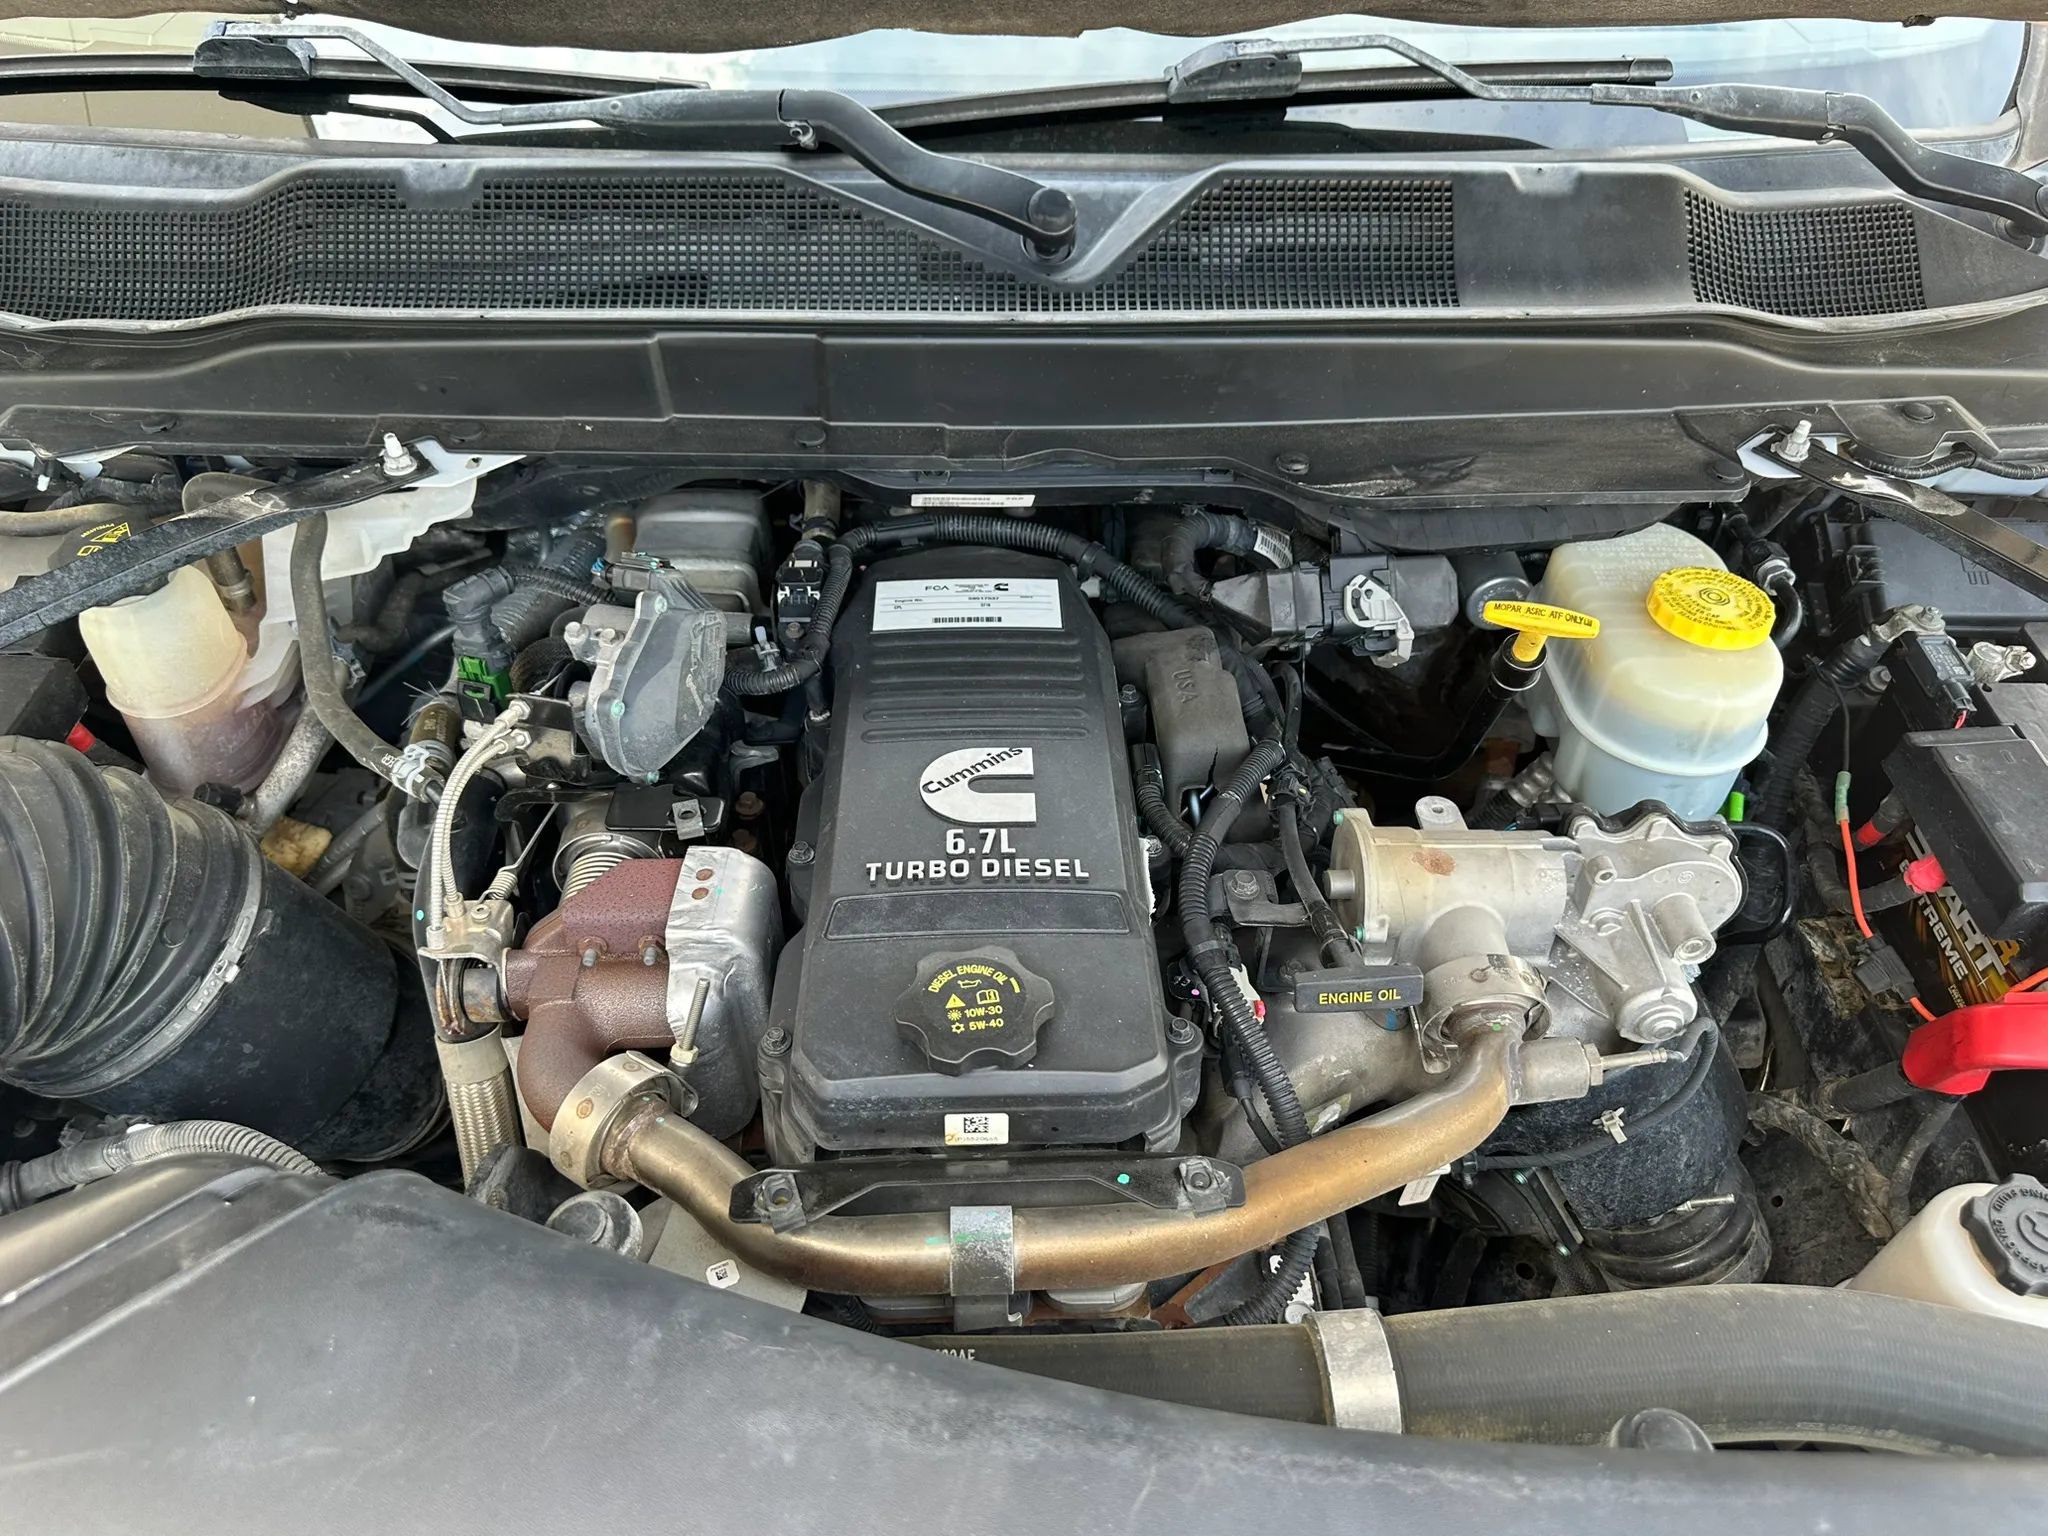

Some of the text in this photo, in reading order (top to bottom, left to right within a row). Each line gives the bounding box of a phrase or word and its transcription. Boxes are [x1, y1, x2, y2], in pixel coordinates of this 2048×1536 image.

[1493, 603, 1522, 614] MOPAR
[1548, 611, 1564, 620] ATF
[1564, 613, 1585, 625] ONLY
[1171, 669, 1199, 704] USA
[922, 747, 1023, 794] Cummins
[946, 828, 1017, 856] 6.7L
[865, 858, 1090, 884] TURBO DIESEL
[1898, 857, 1968, 980] ETREME
[928, 964, 1009, 993] DIESEL ENGINE OIL
[1319, 988, 1401, 1005] ENGINE OIL
[964, 1005, 1003, 1018] 10W-30
[968, 1018, 1004, 1031] 5W-40
